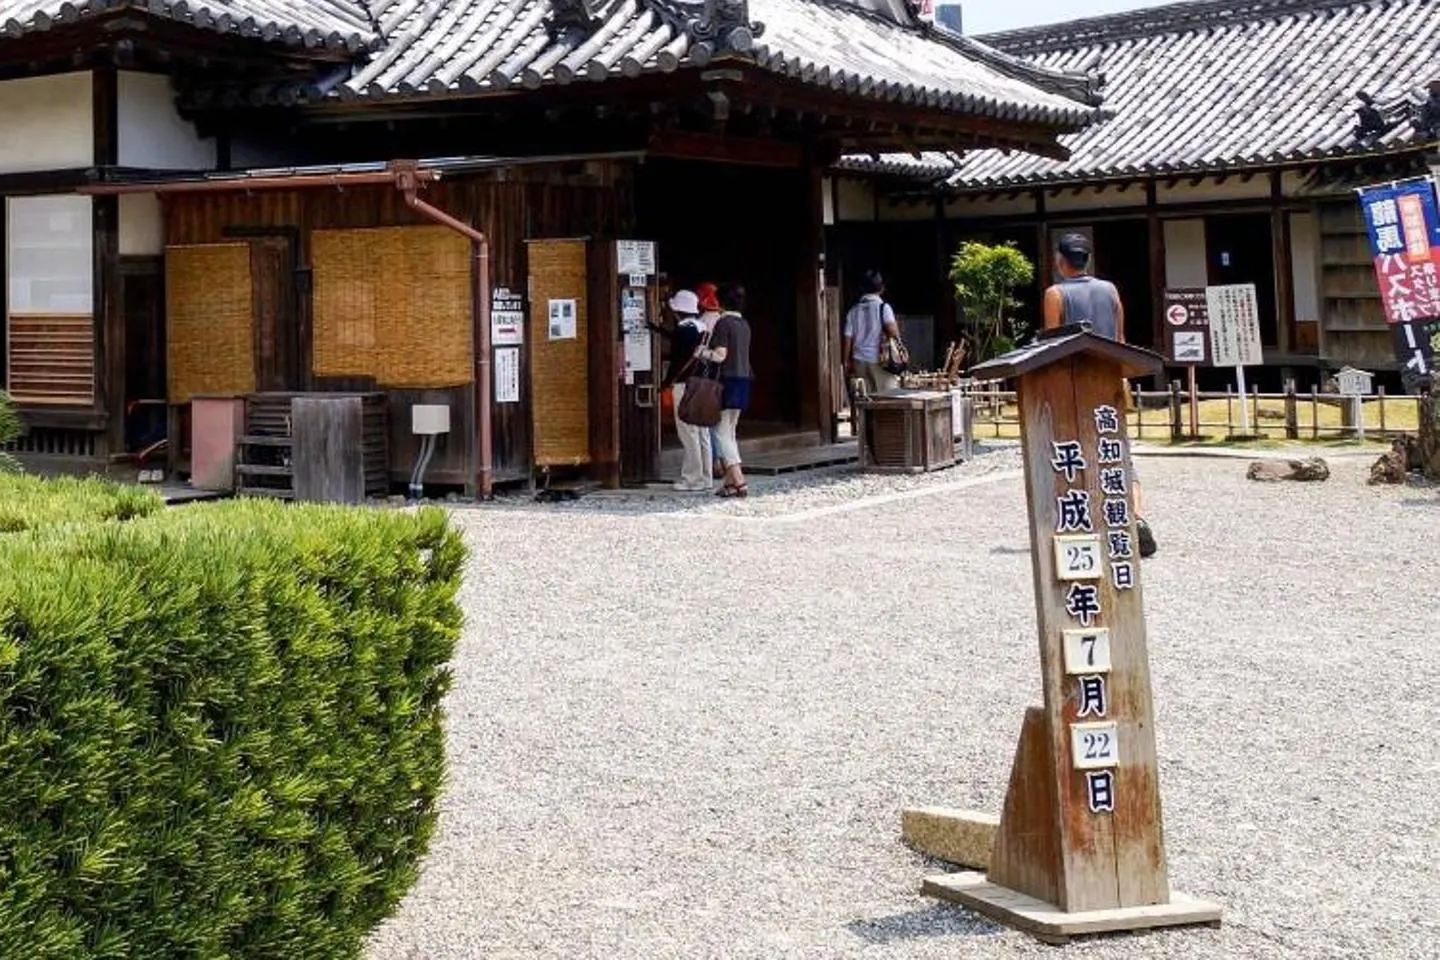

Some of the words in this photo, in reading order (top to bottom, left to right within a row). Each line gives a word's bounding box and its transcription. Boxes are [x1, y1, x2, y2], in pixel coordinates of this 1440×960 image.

[1094, 406, 1133, 588] 高知城観覧日
